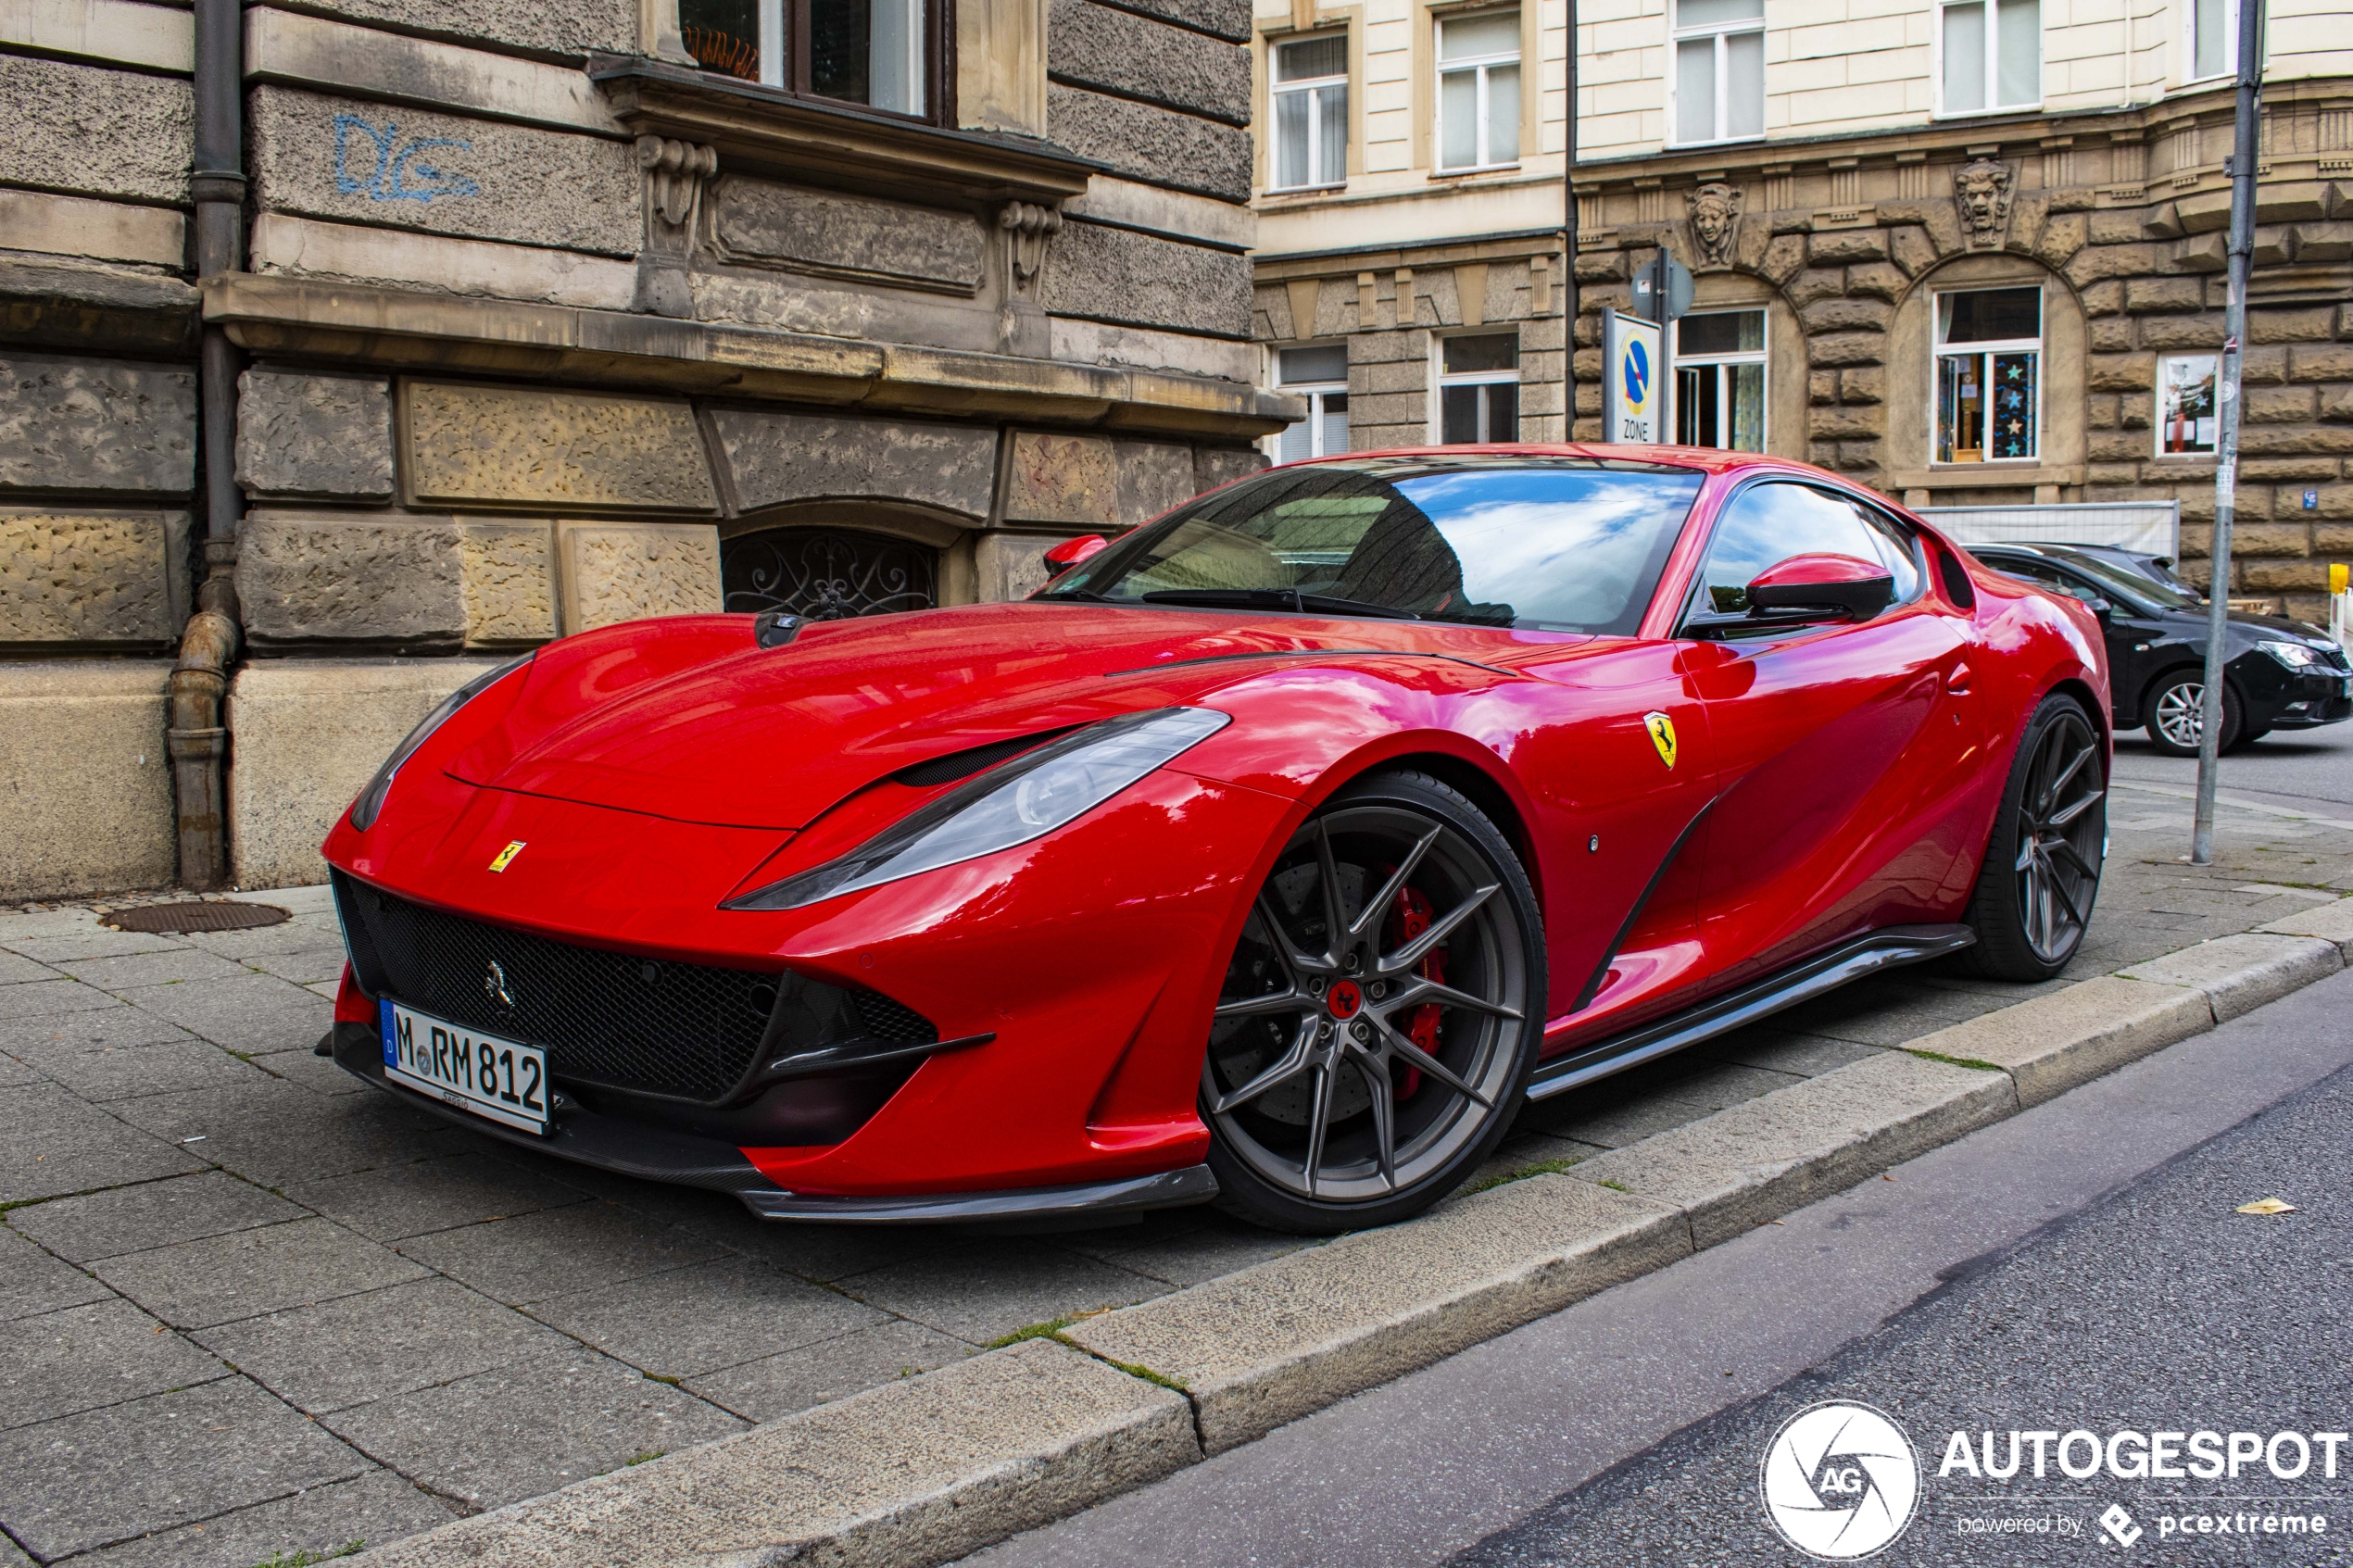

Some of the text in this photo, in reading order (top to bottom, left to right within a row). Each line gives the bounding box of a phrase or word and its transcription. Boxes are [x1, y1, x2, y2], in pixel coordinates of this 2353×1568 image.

[1624, 419, 1648, 442] ZONE
[387, 1039, 394, 1053] D
[396, 1011, 415, 1067] M
[432, 1025, 472, 1090] RM
[479, 1042, 544, 1112] 812
